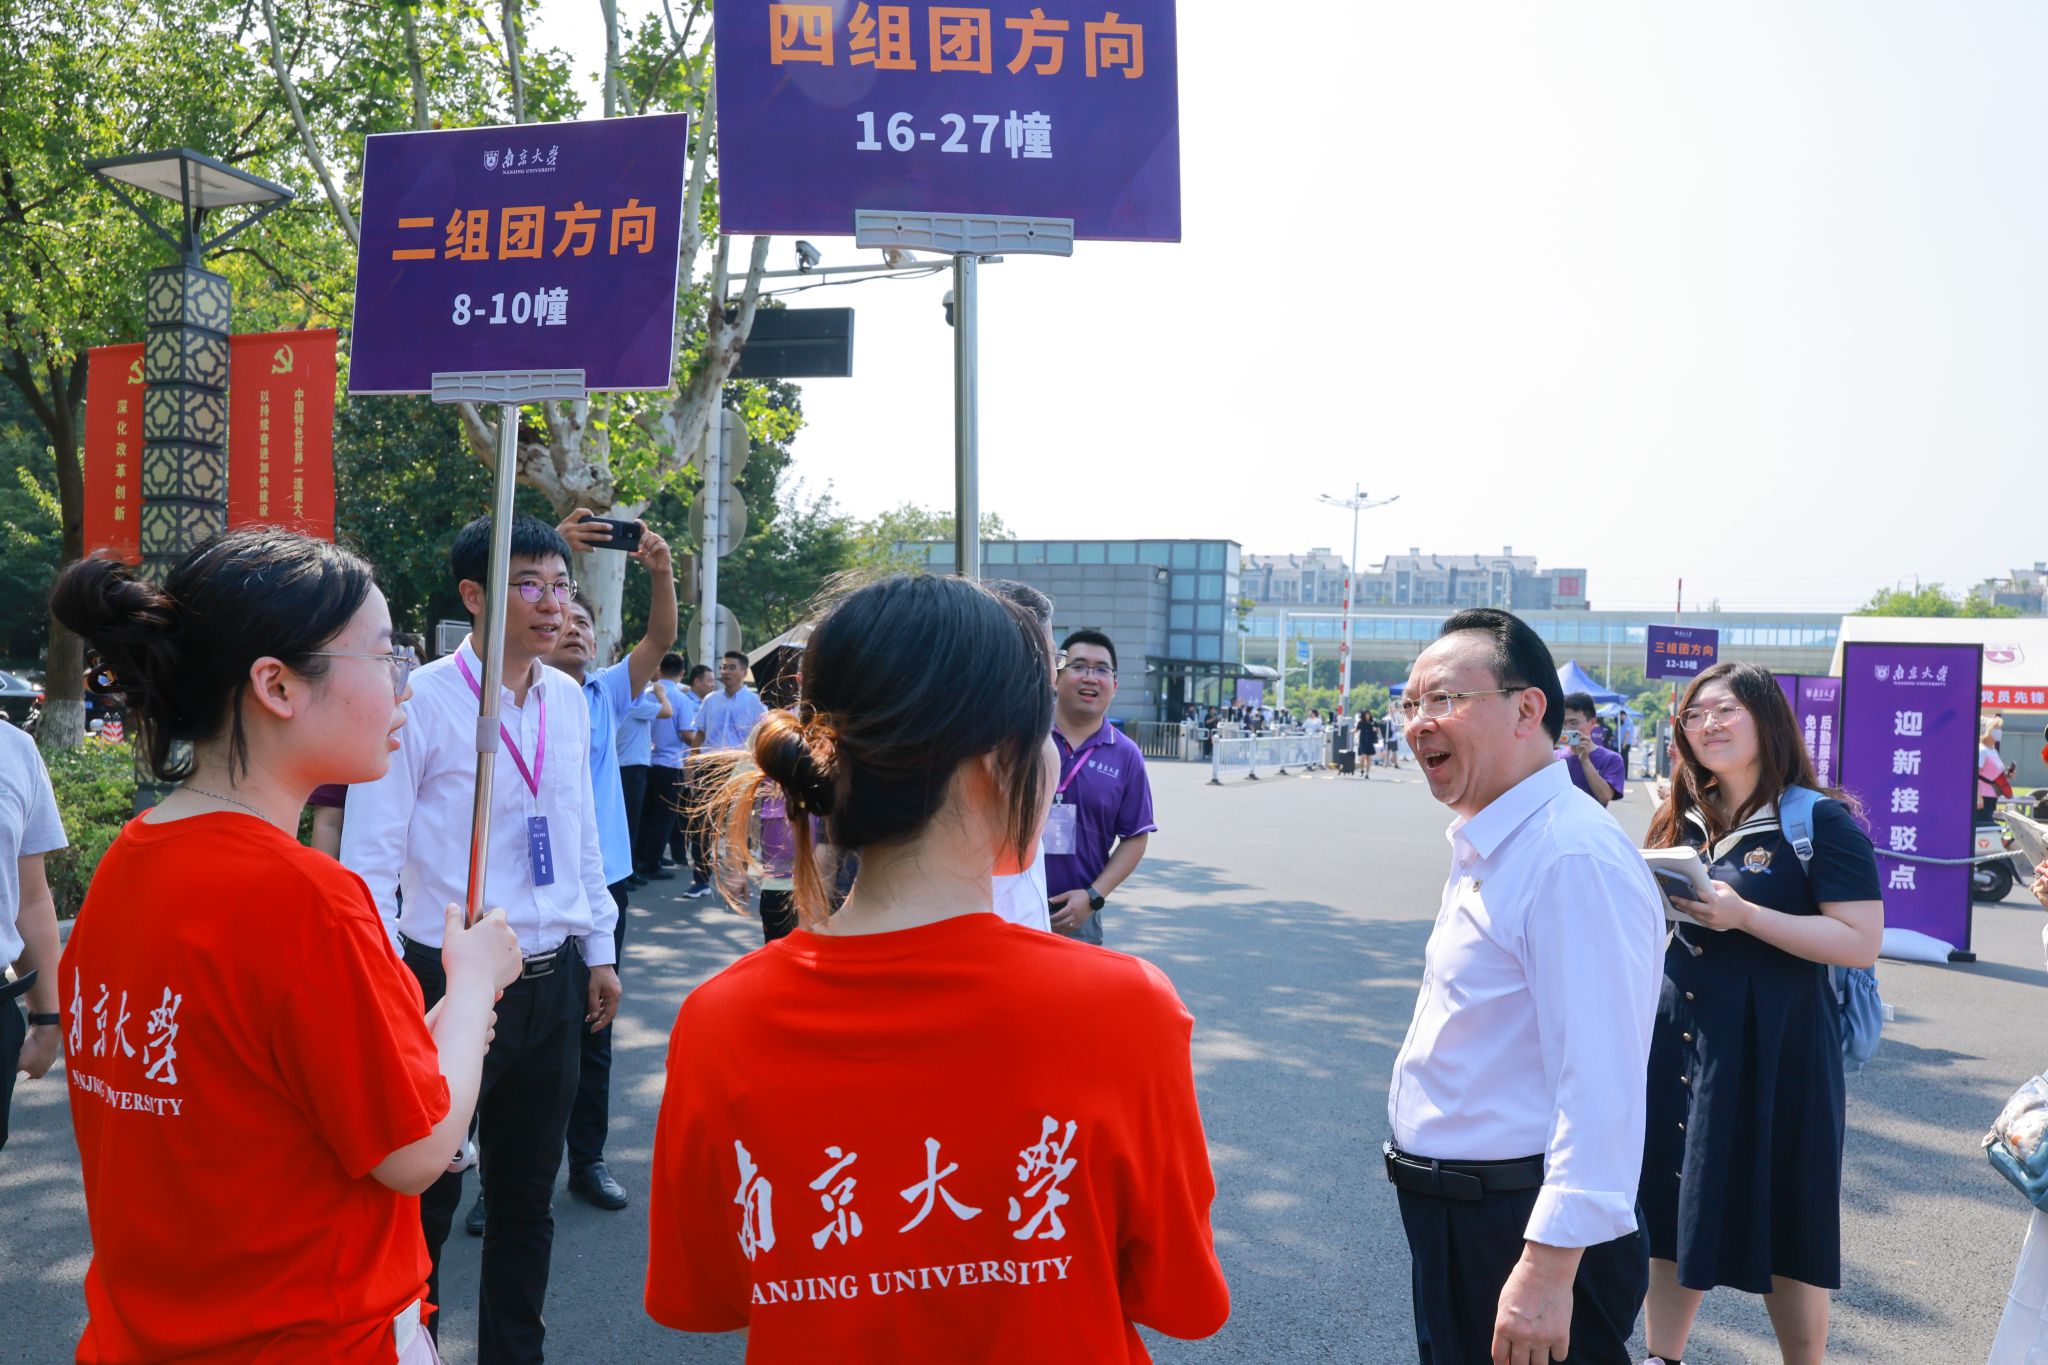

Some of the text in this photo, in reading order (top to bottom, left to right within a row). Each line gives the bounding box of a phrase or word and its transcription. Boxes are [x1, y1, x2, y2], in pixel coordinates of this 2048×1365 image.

[769, 2, 1144, 79] 四组团方向
[856, 110, 1053, 159] 16-27幢
[392, 198, 656, 260] 二组团方向
[452, 287, 569, 327] 8-10幢
[114, 400, 128, 521] 深化改革创新
[293, 387, 305, 516] 中国特色世界一流南大
[1655, 641, 1714, 656] 三组团方向
[1888, 711, 1923, 890] 迎新接驳点
[869, 1256, 1073, 1296] UNIVERSITY
